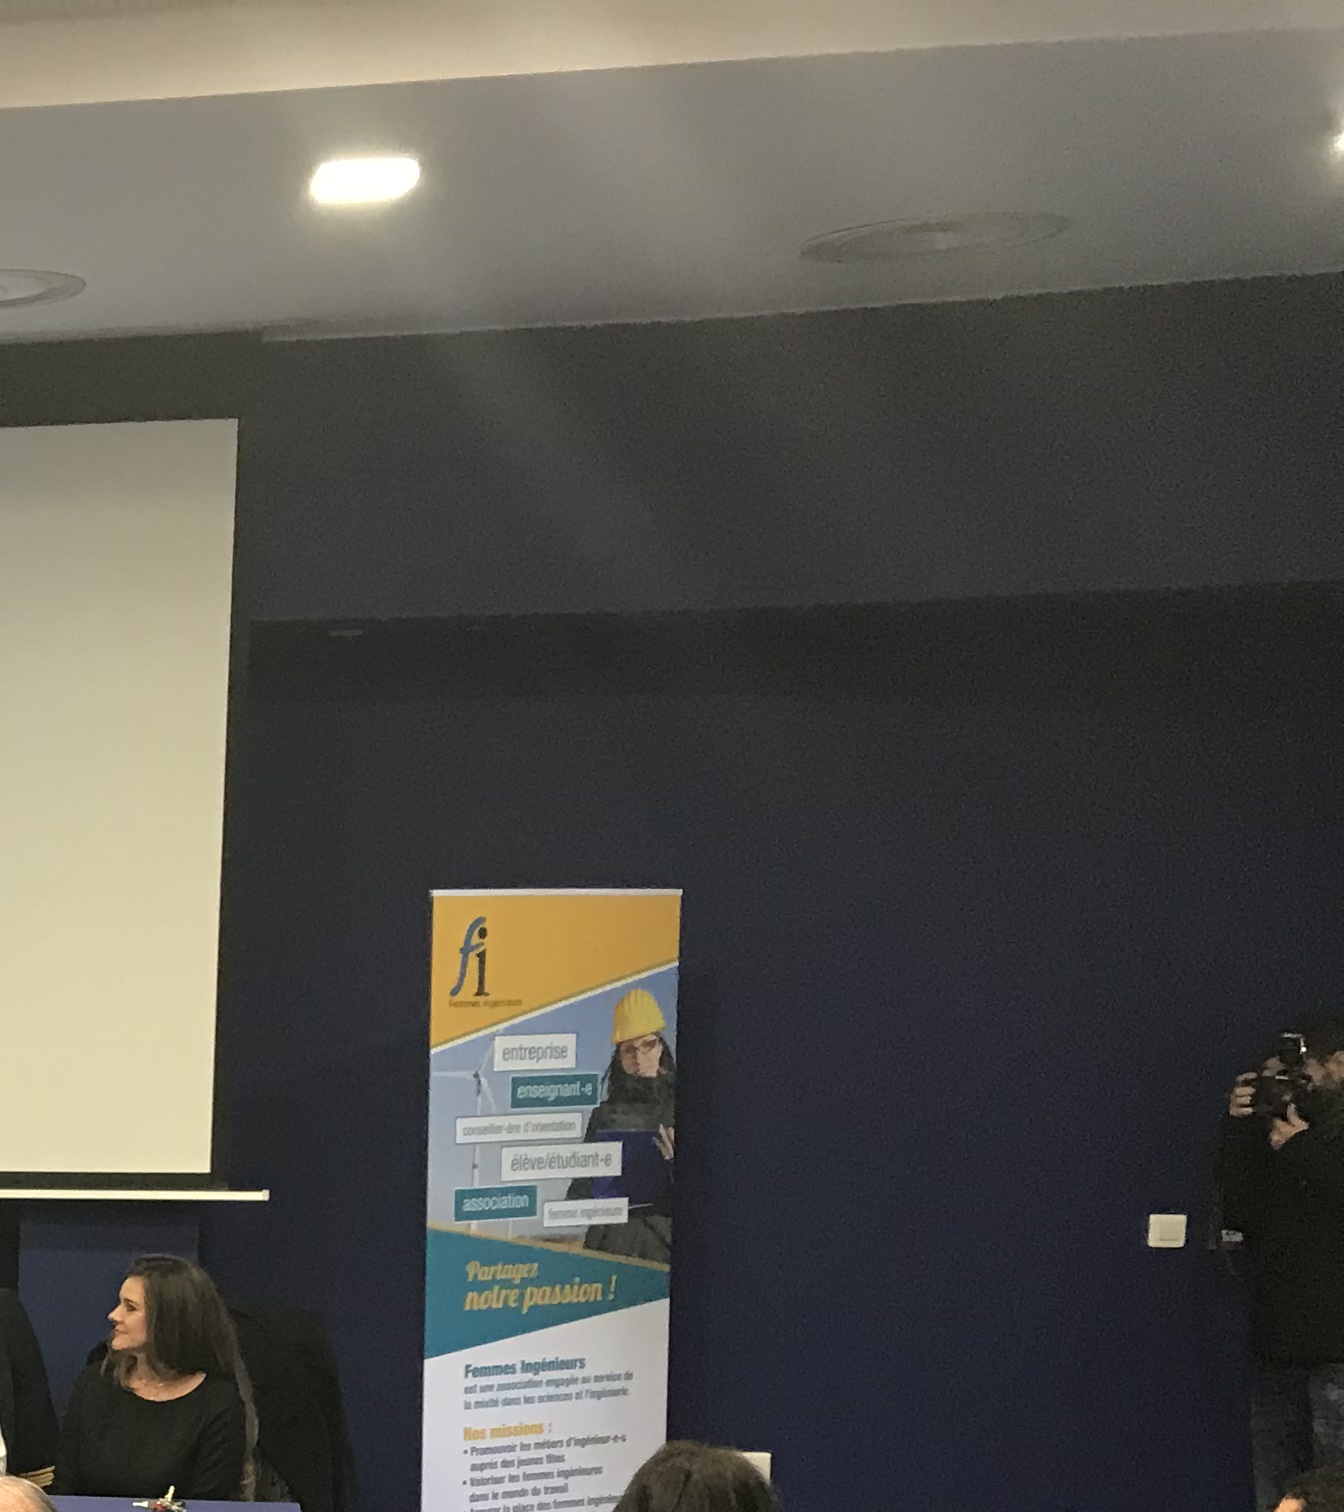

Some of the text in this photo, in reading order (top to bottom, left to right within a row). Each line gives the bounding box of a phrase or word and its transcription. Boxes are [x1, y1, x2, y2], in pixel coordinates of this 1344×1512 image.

[502, 1042, 568, 1064] entreprise
[516, 1080, 593, 1101] enseignant-e
[511, 1151, 613, 1173] élève/étudiant-e
[463, 1192, 530, 1212] association
[466, 1260, 539, 1285] Partagez
[464, 1274, 618, 1315] notre passion !
[464, 1356, 586, 1379] Femmes Ingénieurs
[464, 1426, 486, 1441] Nos
[490, 1421, 544, 1439] missions
